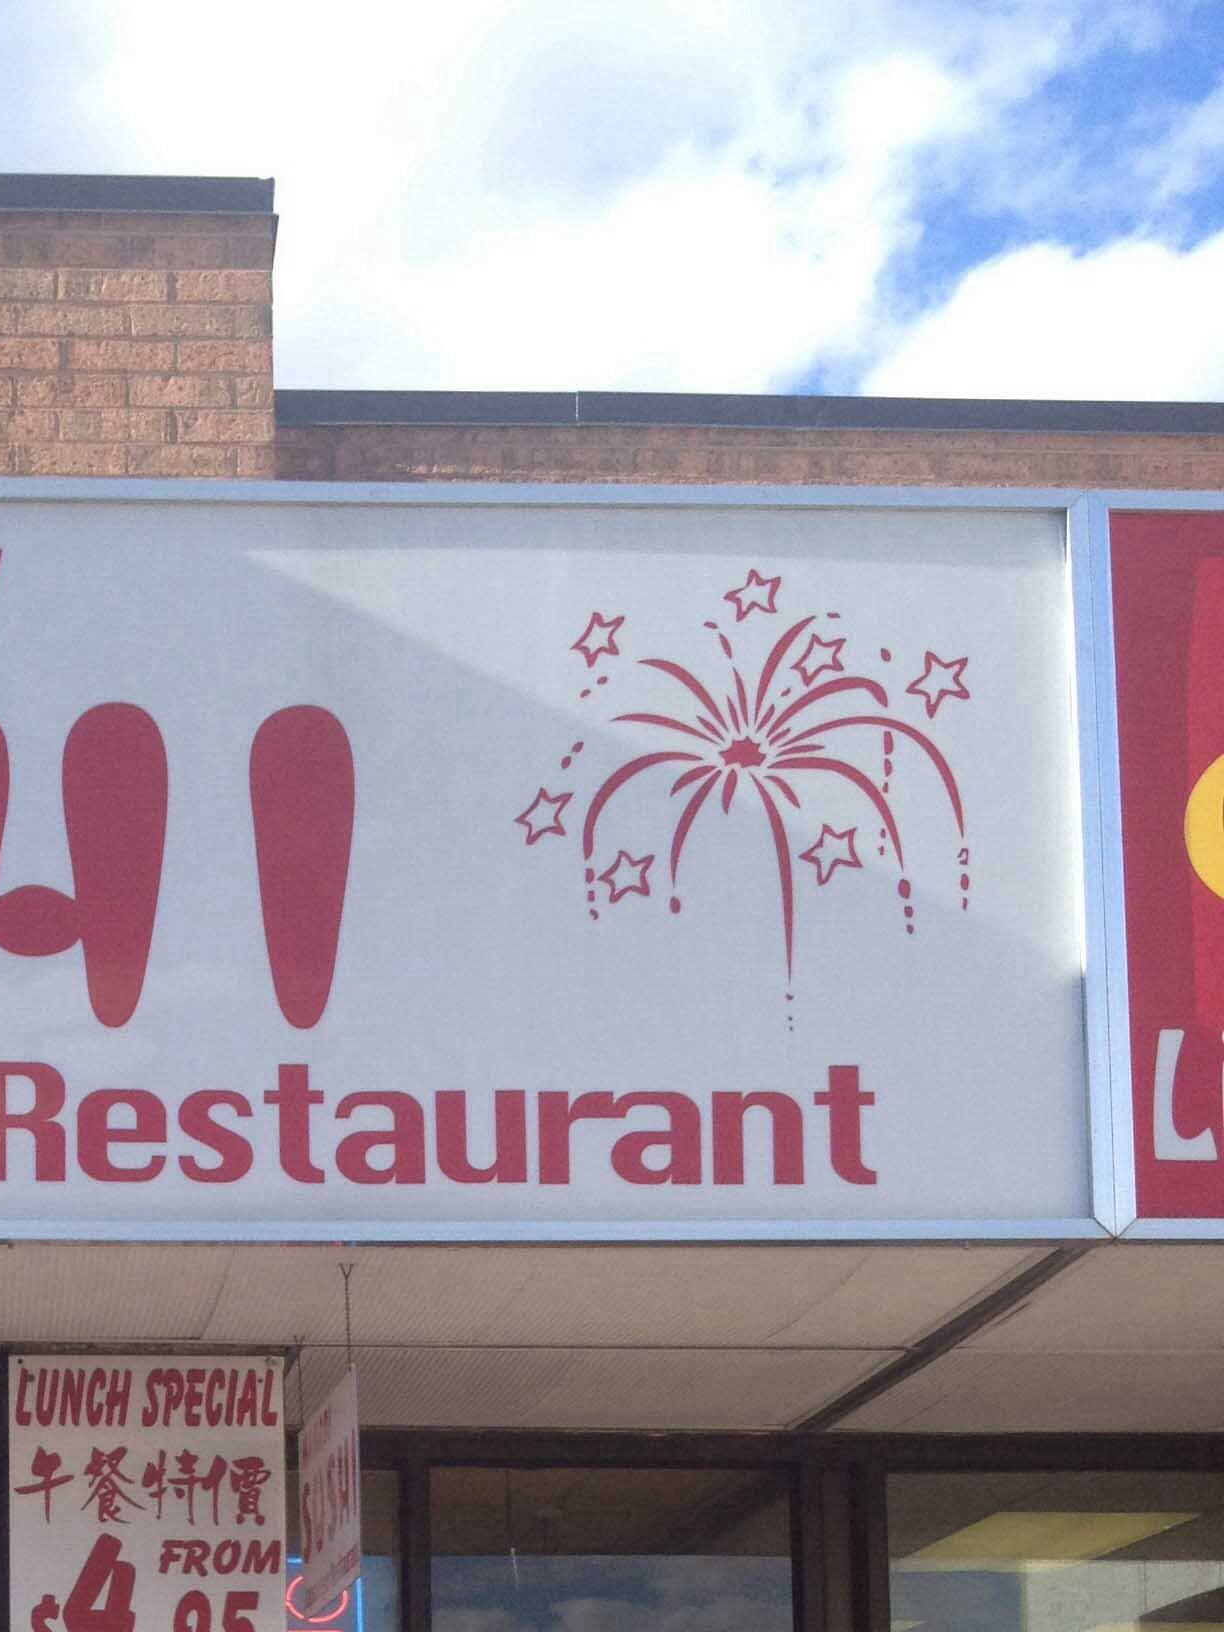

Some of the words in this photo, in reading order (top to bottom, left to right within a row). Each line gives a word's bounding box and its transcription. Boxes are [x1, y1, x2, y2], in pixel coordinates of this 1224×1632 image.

[15, 1367, 133, 1427] LUNCH
[141, 1367, 278, 1428] SPECIAL
[14, 1445, 273, 1525] 午餐特價
[158, 1538, 281, 1577] FROM
